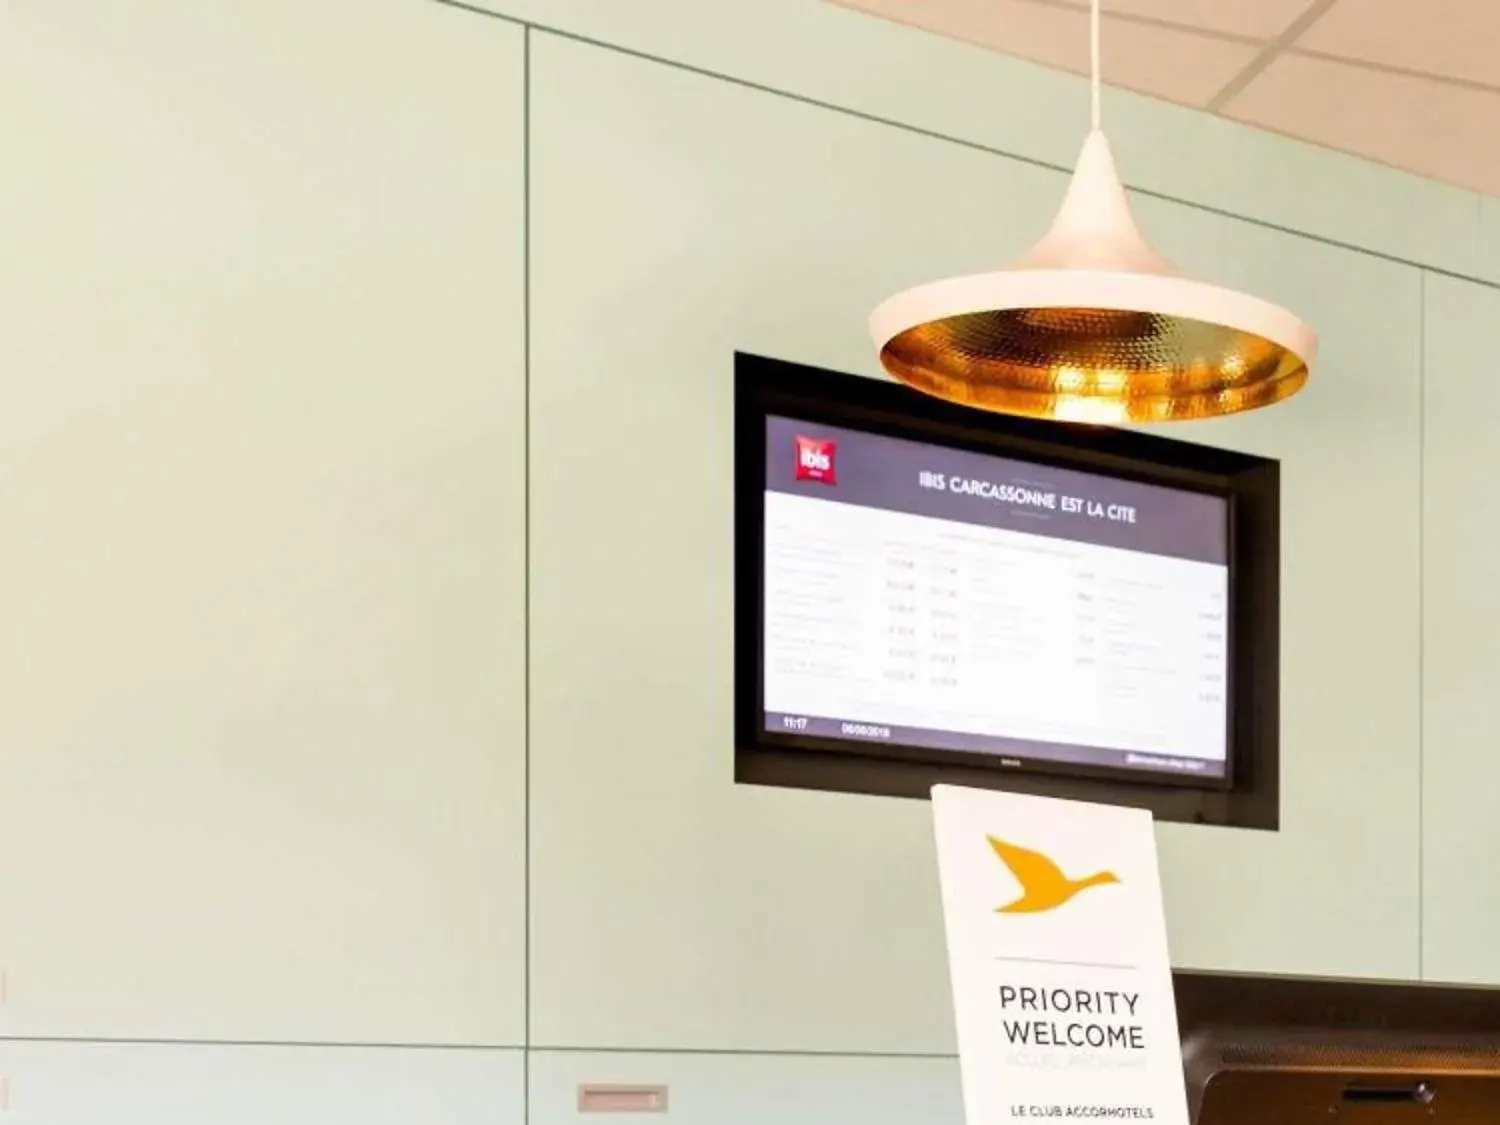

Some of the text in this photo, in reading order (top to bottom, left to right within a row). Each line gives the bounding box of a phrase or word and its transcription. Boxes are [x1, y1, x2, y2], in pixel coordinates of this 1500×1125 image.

[919, 471, 1137, 523] IBIS CARCASSONNE EST LA CITE
[999, 985, 1139, 1016] PRIORITY
[1002, 1020, 1145, 1049] WELCOME
[1010, 1105, 1155, 1119] LE CLUB ACCORHOTELS
